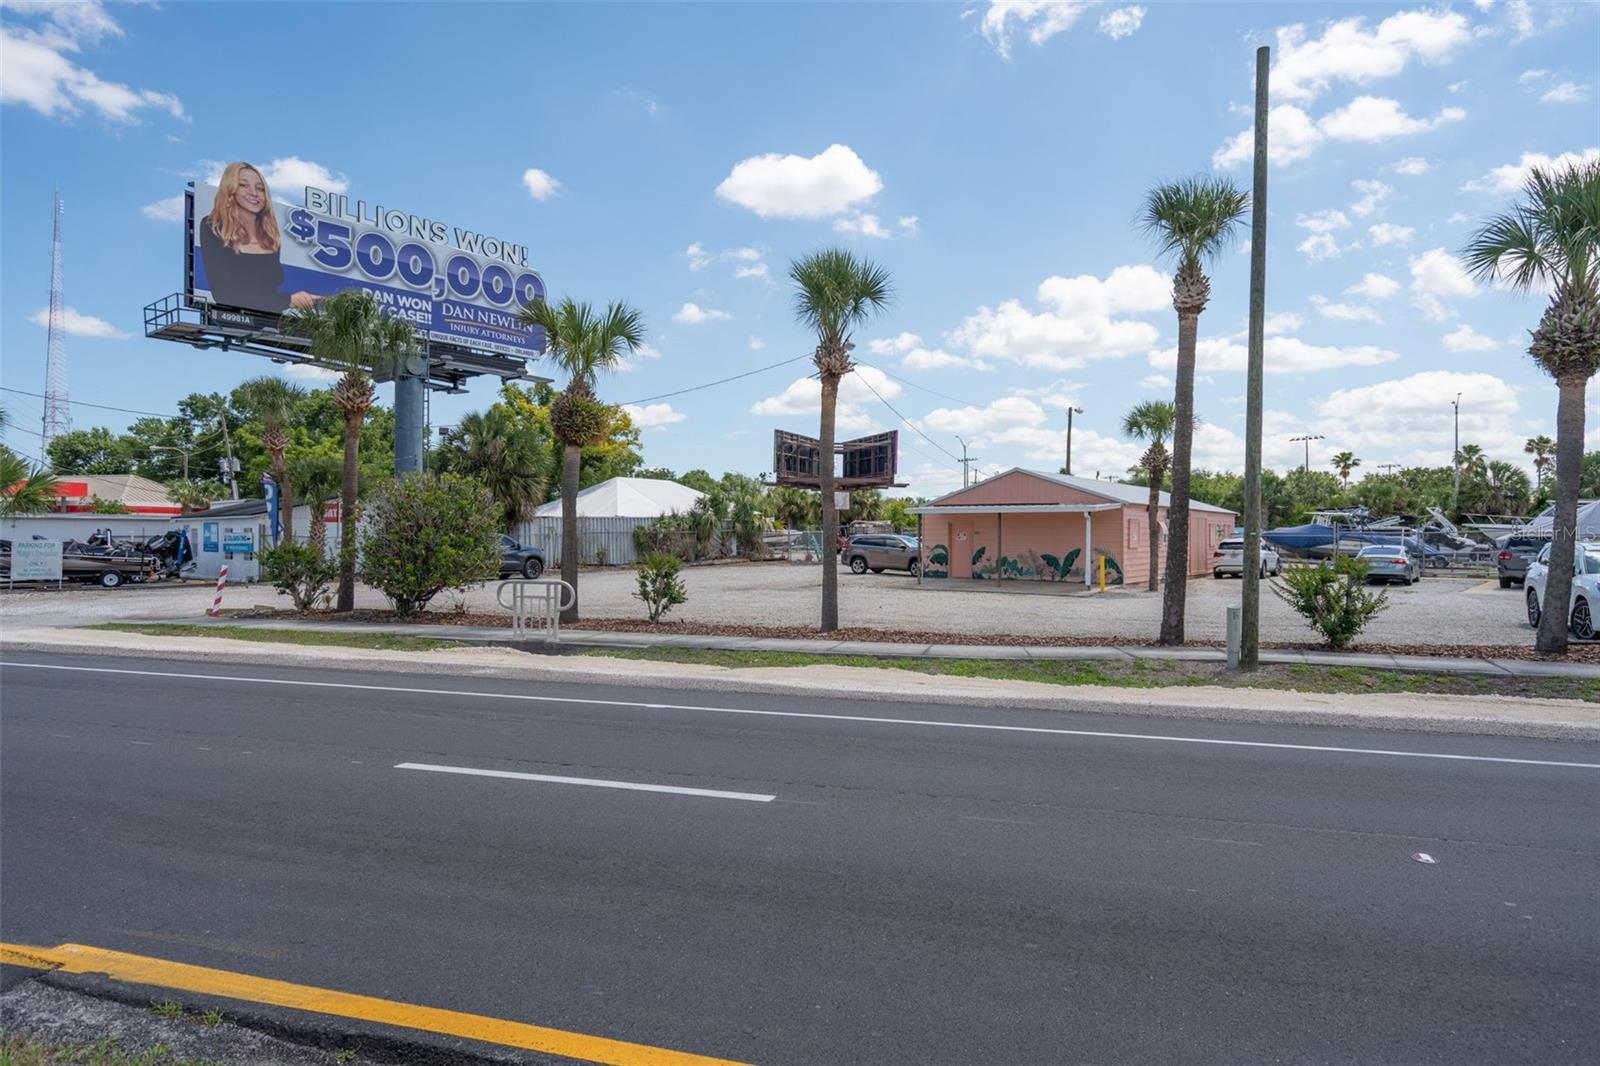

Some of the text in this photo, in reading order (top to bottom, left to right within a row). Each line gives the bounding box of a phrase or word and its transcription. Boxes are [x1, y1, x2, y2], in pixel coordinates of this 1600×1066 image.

[305, 186, 529, 268] BILLIONS WON!
[287, 208, 547, 311] $500,000
[397, 294, 432, 313] WON
[441, 303, 474, 321] DAN
[387, 306, 432, 325] CASE!!
[450, 322, 526, 346] INJURY ATTORNEYS
